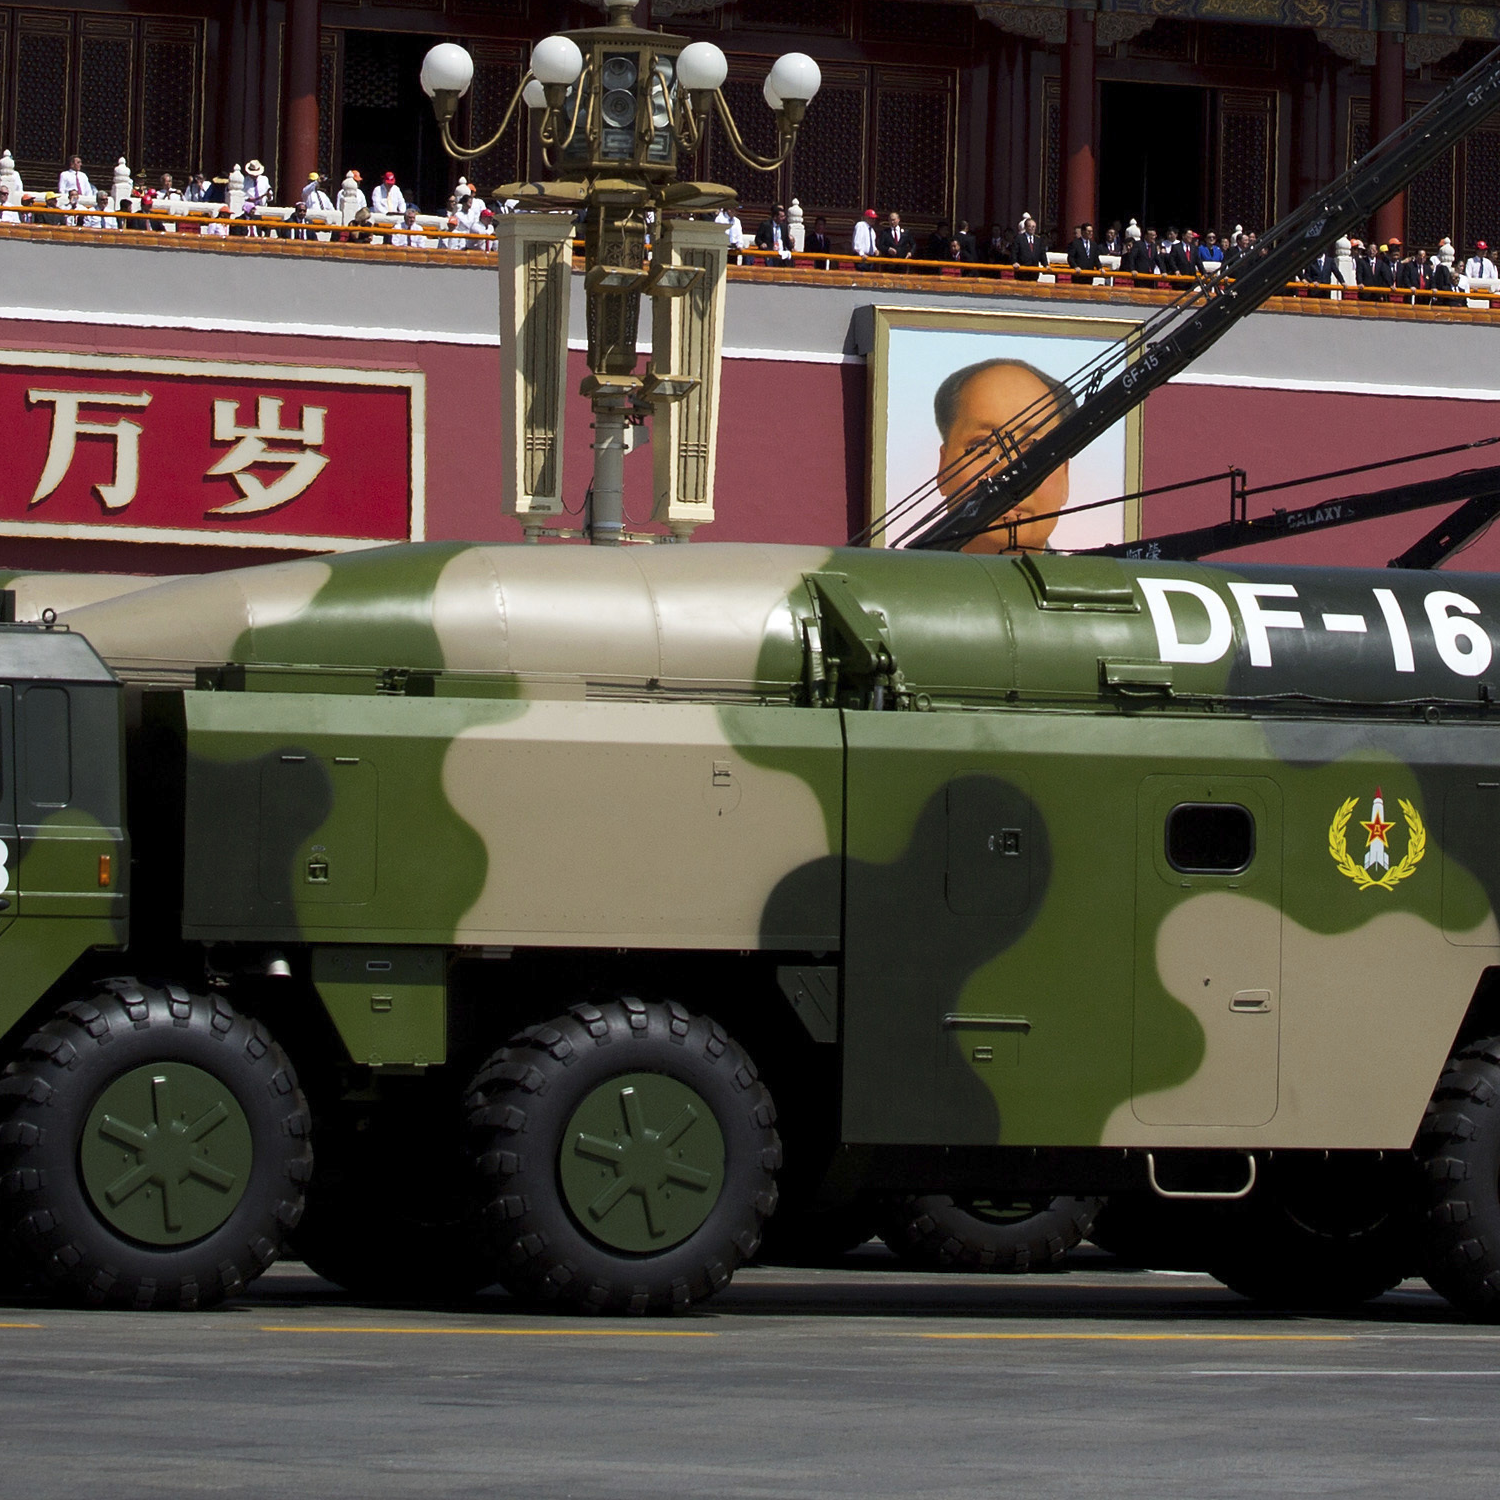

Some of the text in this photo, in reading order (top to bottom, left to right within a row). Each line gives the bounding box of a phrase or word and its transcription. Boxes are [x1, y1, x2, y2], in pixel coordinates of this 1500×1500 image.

[1122, 354, 1159, 388] GF-15
[1287, 505, 1342, 529] GALAXY
[1136, 577, 1494, 677] DF-16
